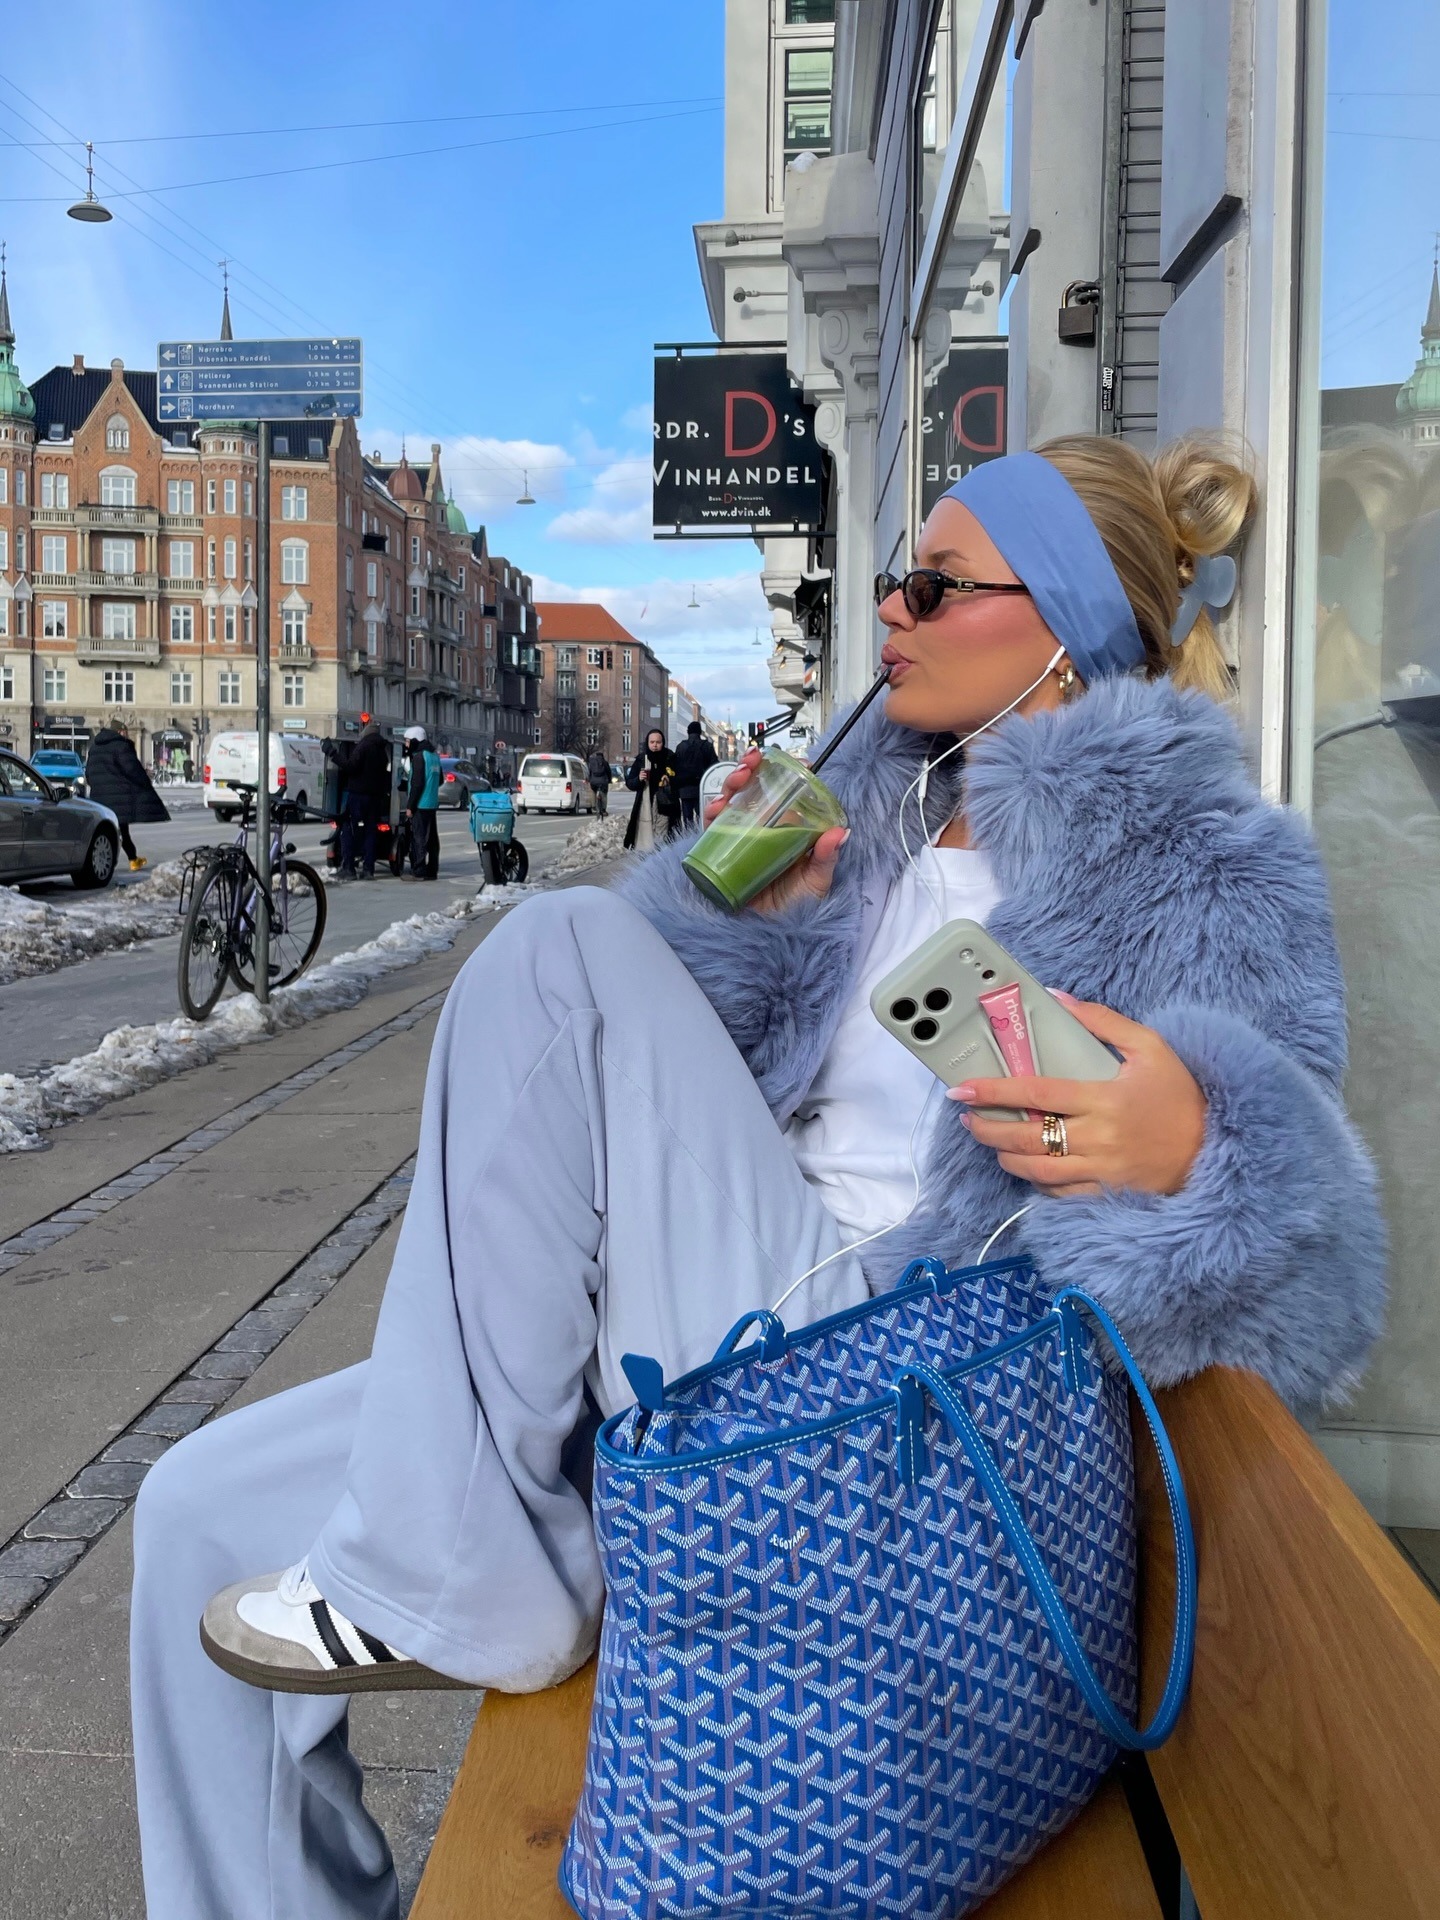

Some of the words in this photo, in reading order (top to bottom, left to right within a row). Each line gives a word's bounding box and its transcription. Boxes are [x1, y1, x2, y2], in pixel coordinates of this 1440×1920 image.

[701, 506, 771, 517] www.dvin.dk
[481, 823, 505, 834] Wolt
[1005, 999, 1025, 1040] rhode
[948, 1042, 978, 1070] rhode
